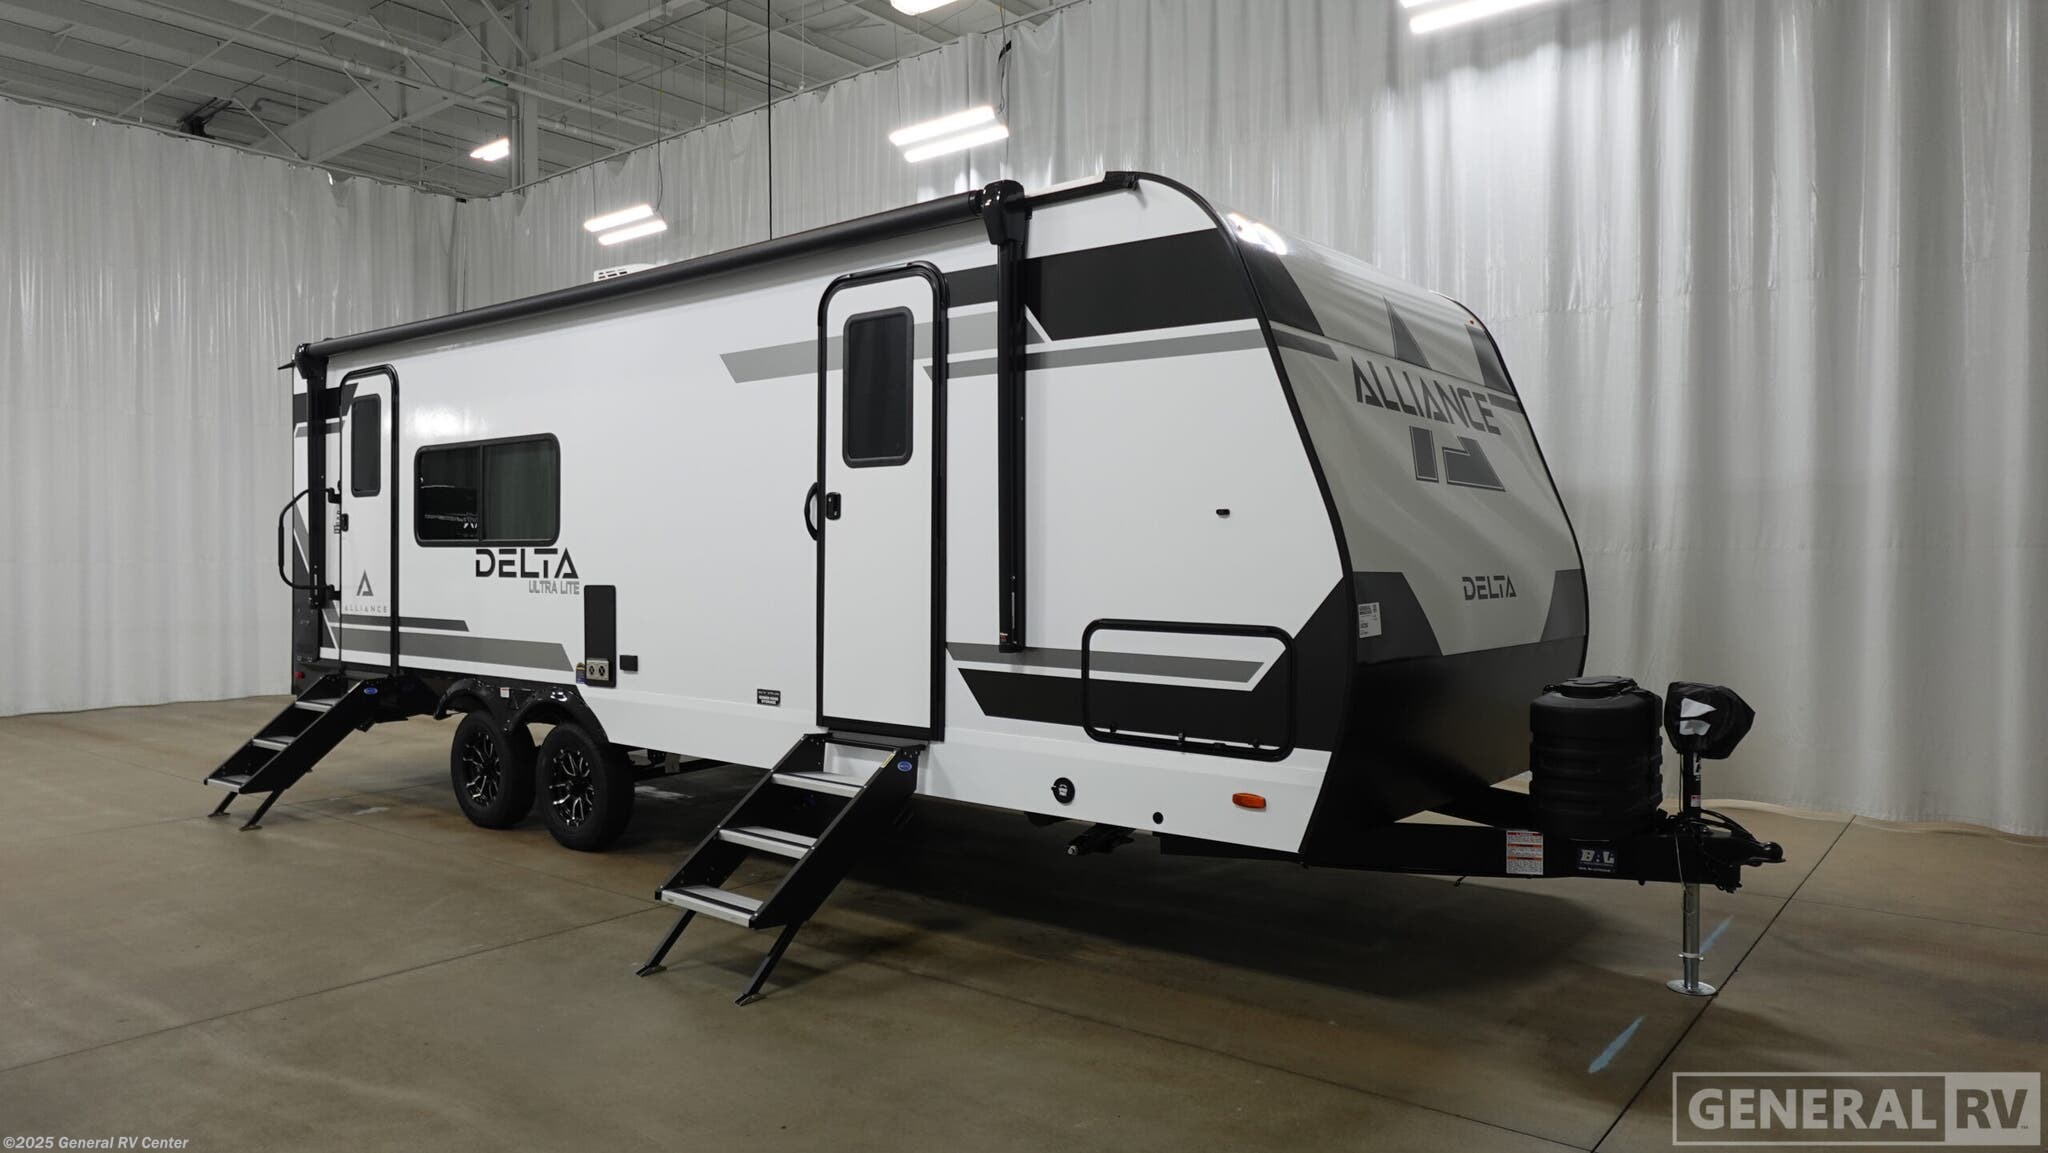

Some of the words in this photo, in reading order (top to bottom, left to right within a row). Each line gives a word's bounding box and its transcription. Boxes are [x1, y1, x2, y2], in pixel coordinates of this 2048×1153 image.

[1351, 356, 1502, 436] ALLIANCE
[475, 547, 579, 579] DELTA
[528, 580, 558, 595] ULTRA
[560, 581, 580, 596] LITE
[1462, 575, 1517, 601] DELTA
[343, 604, 388, 614] ALLIANCE
